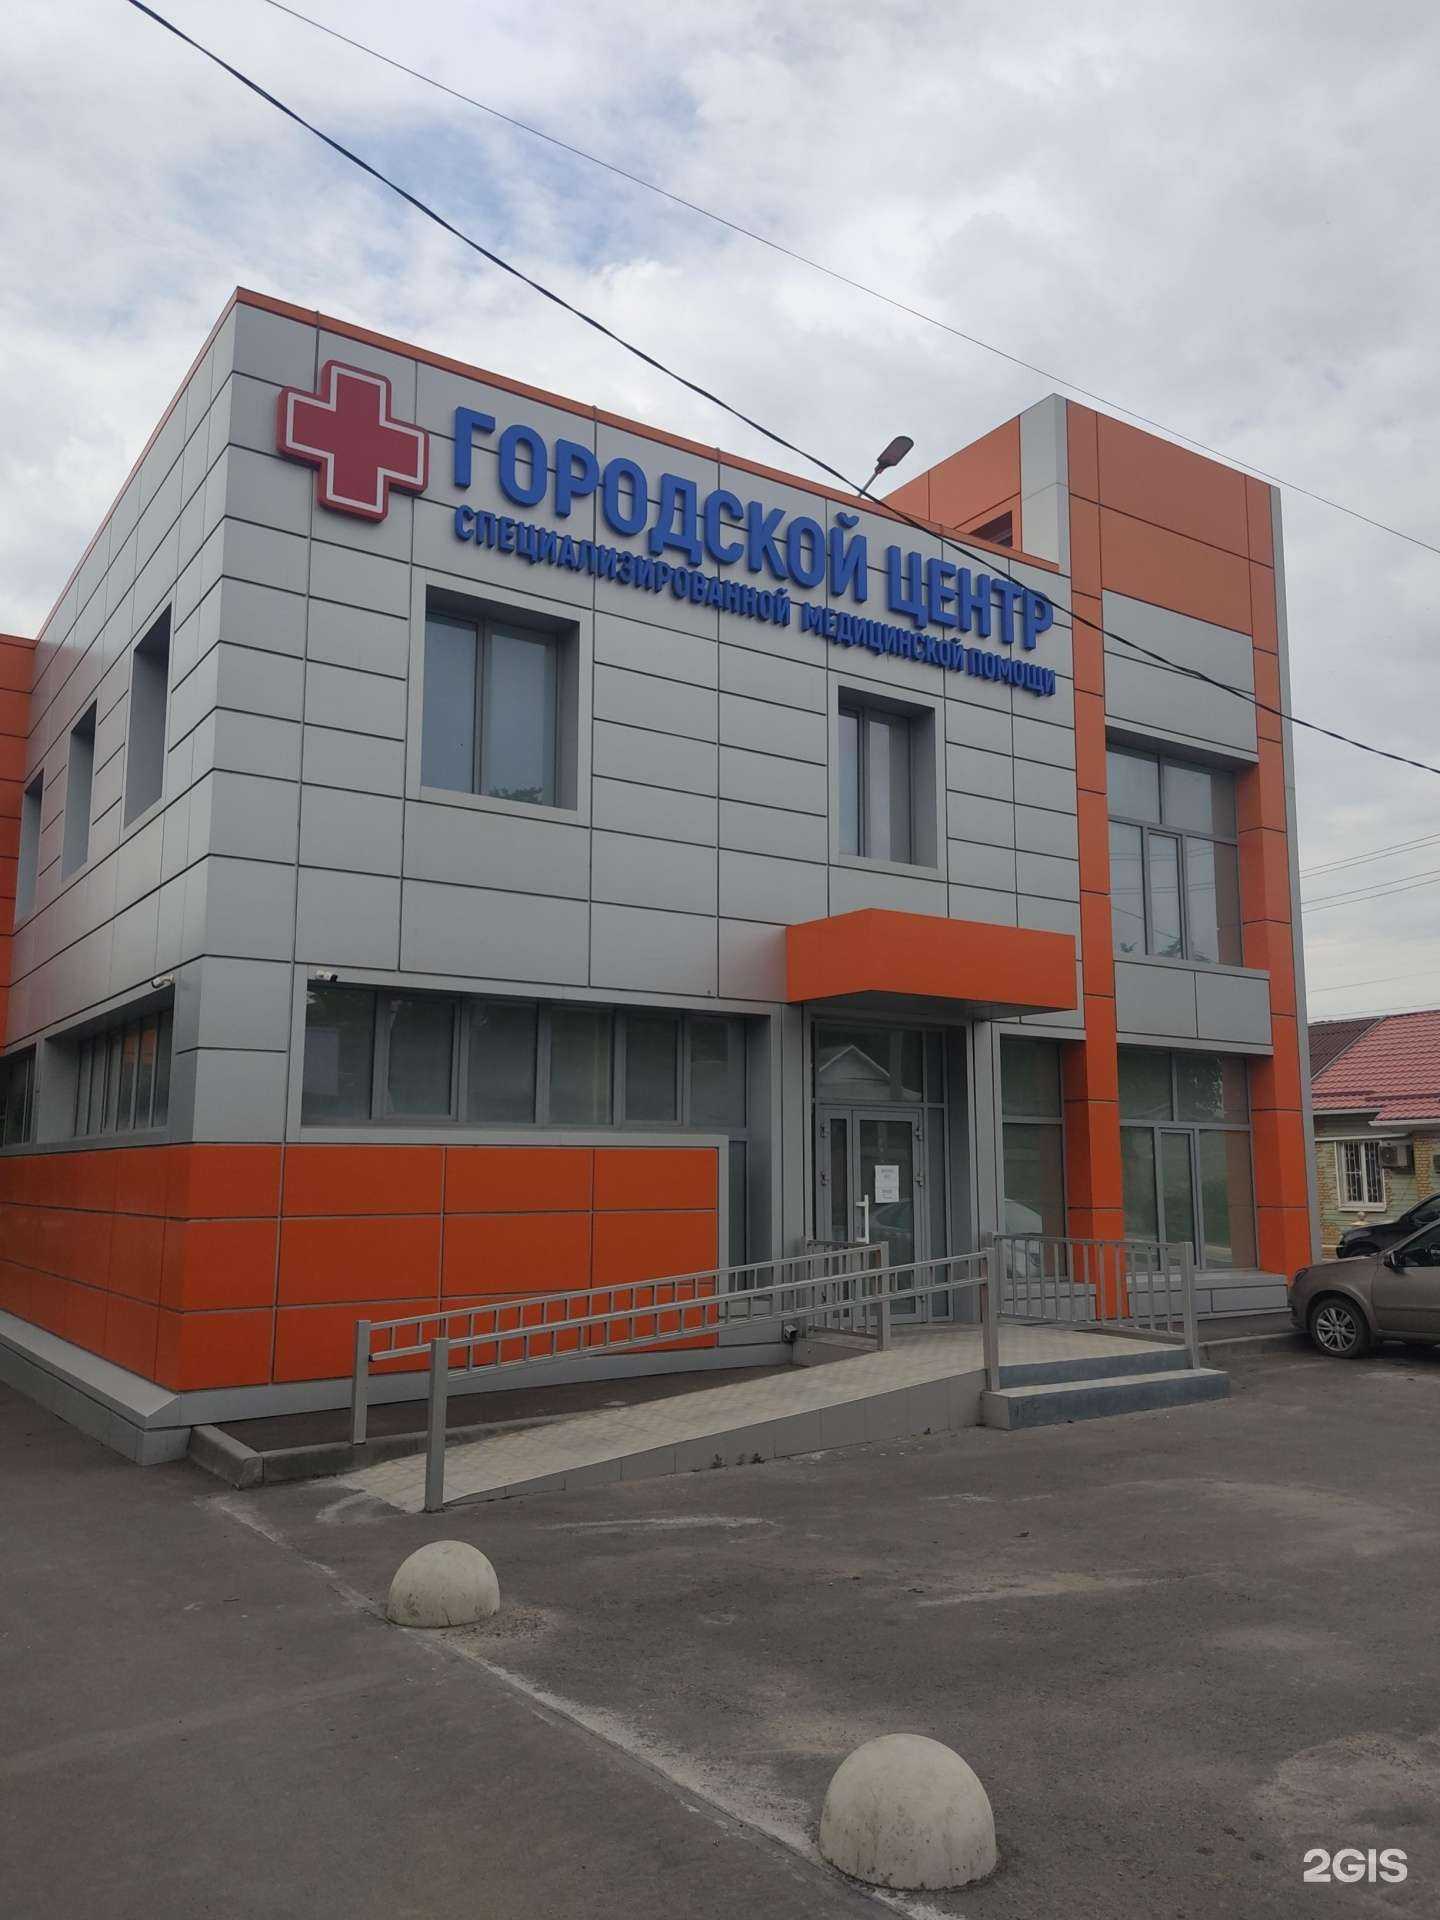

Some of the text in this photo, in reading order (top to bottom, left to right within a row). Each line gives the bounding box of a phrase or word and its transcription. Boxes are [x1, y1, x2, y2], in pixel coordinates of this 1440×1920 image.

[454, 406, 1054, 650] ГОРОДСКОЙ ЦЕНТР
[454, 504, 1056, 697] СПЕЦИАЛИЗИРОВАННОЙ МЕДИЦИНСКОЙ ПОМОЩИ
